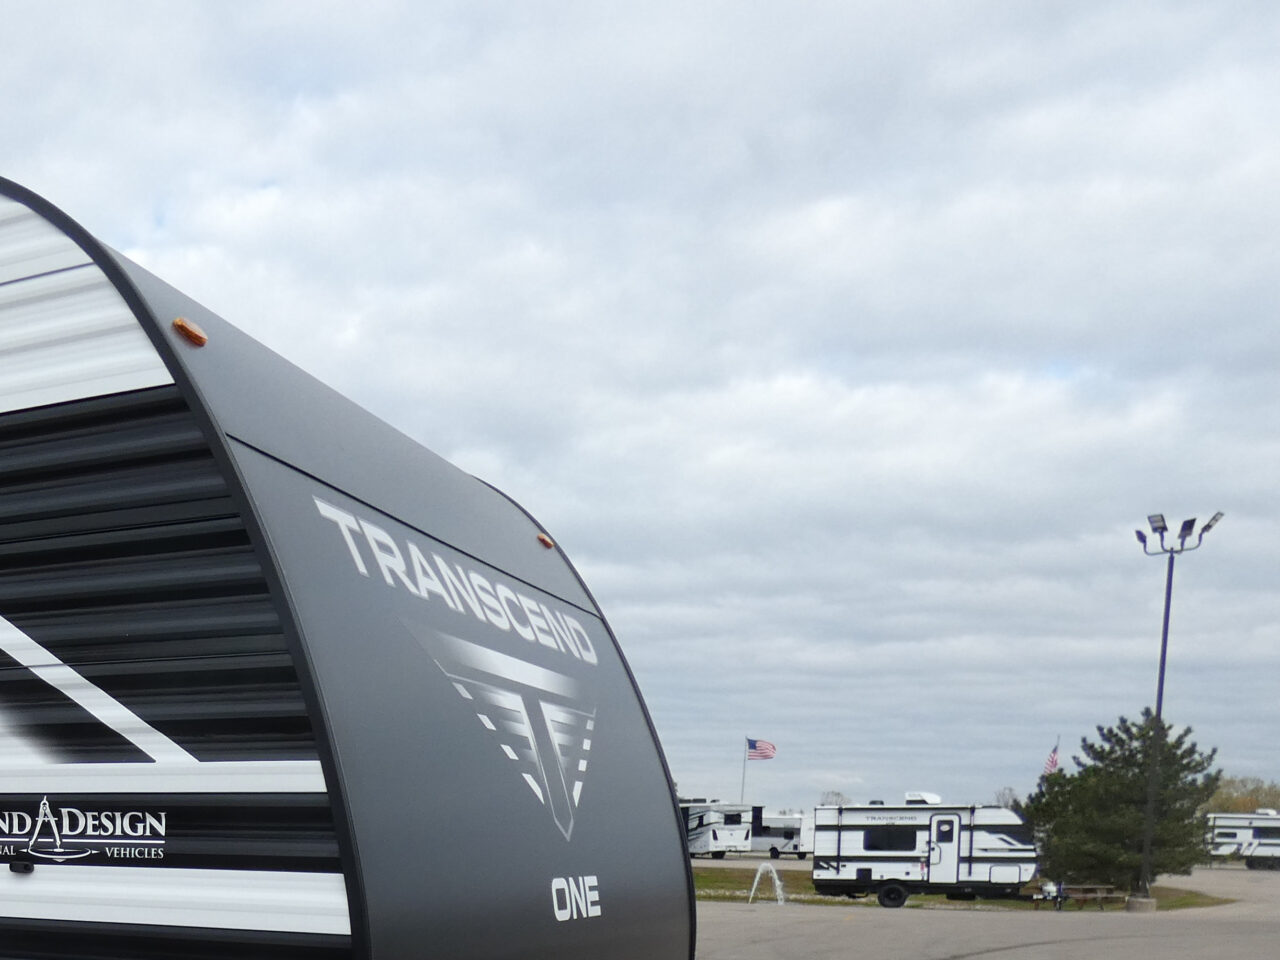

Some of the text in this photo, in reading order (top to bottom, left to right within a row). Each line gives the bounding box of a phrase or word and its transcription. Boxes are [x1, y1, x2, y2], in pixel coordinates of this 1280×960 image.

[312, 496, 598, 665] TRANSCEND
[59, 807, 167, 837] DESIGN
[105, 846, 164, 860] VEHICLES
[551, 875, 601, 922] ONE
